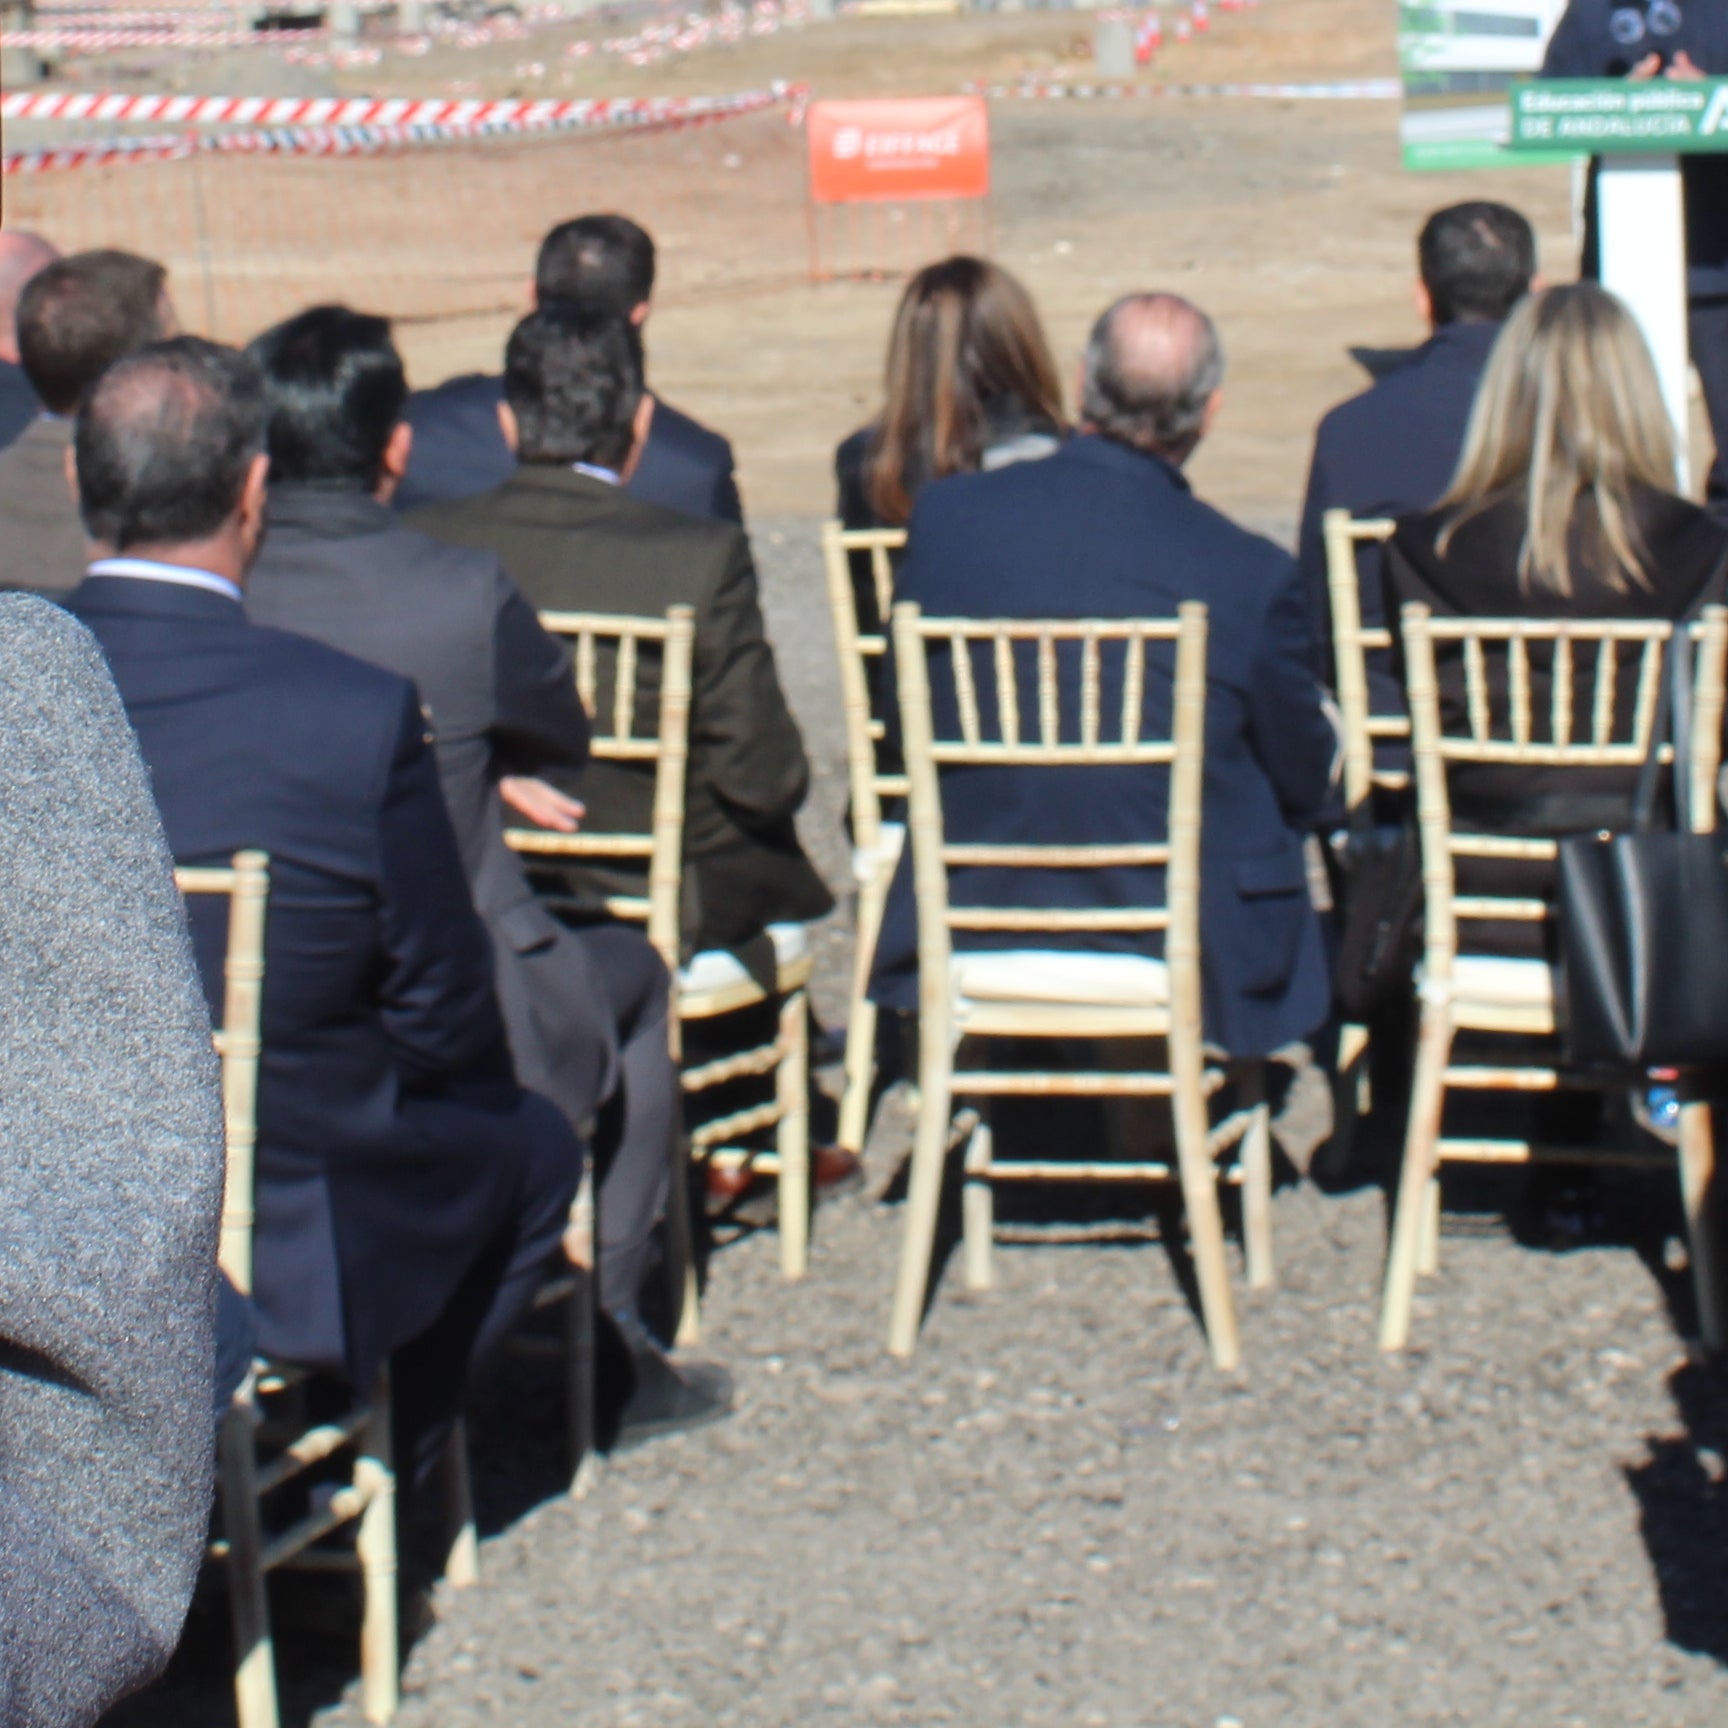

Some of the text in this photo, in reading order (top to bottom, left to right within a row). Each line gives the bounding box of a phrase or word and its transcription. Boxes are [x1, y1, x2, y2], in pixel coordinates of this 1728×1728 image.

[1520, 86, 1705, 116] Educación pública
[1520, 113, 1692, 138] DE ANDALUCÍA
